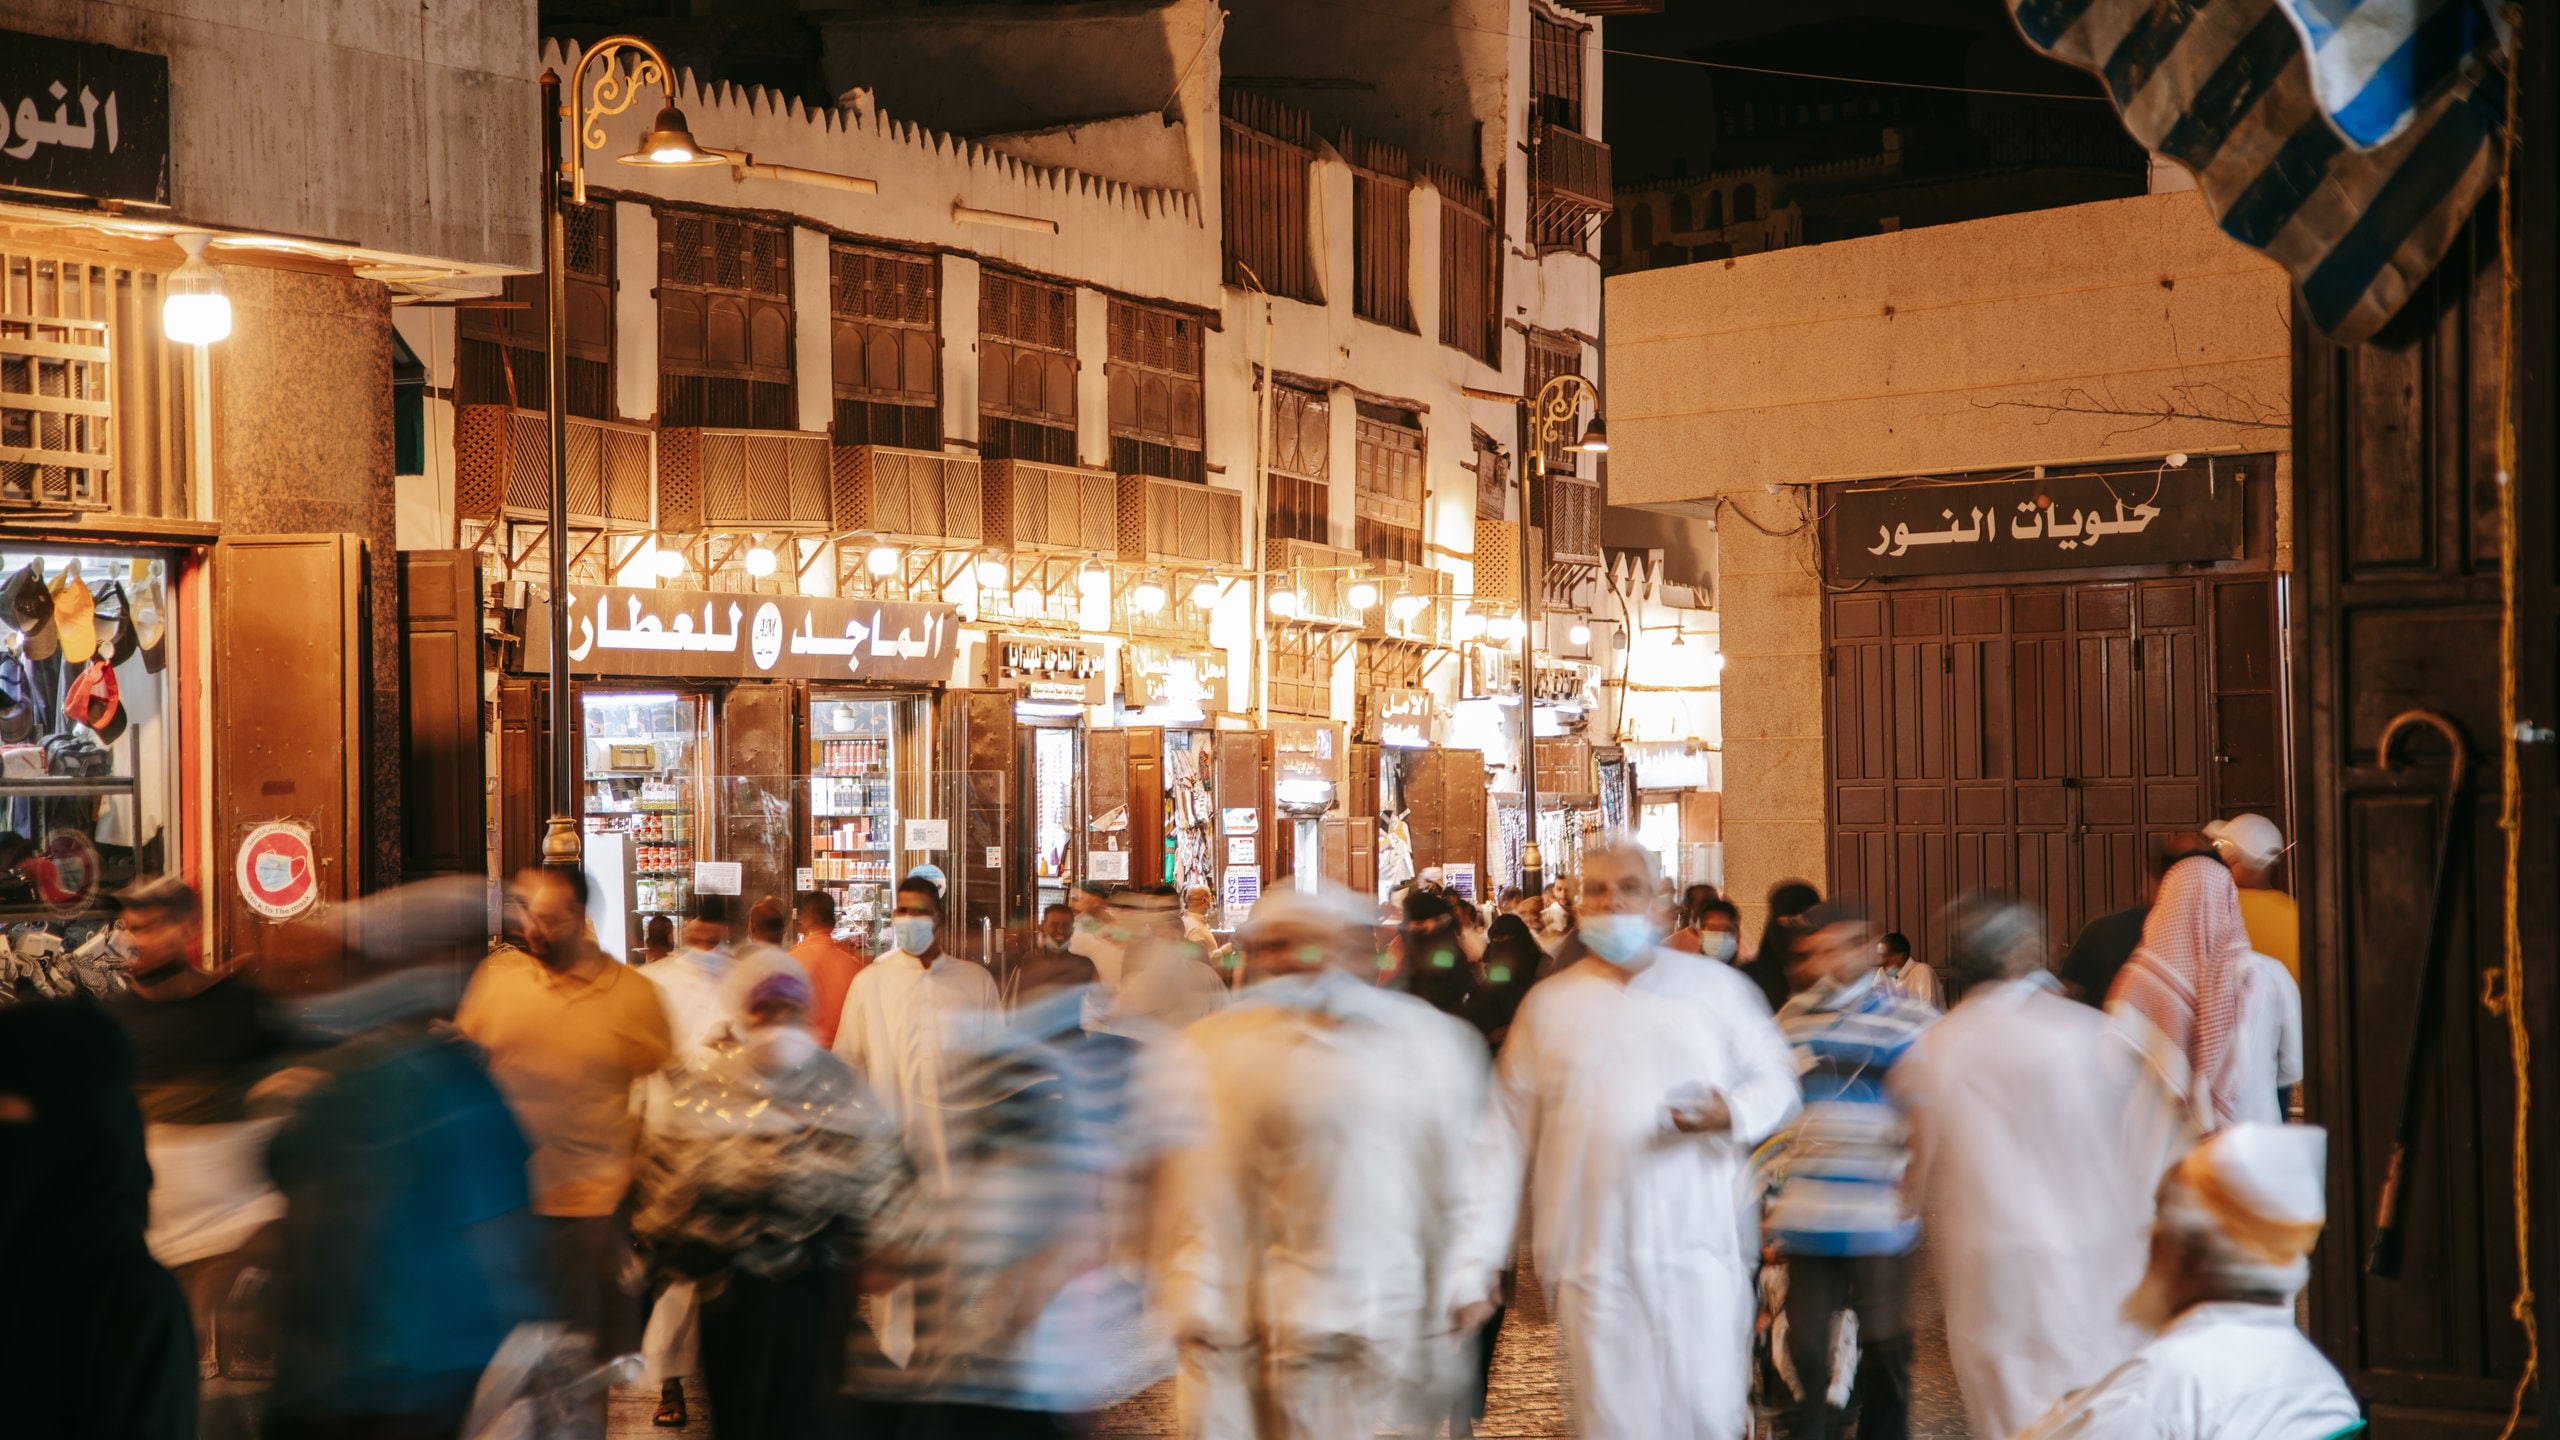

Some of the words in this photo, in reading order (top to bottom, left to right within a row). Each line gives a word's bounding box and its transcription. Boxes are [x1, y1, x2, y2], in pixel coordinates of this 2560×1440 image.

[1867, 505, 1996, 557] النور
[2011, 498, 2161, 550] حلويات
[755, 618, 777, 640] AM
[791, 608, 944, 673] الماجد
[1381, 693, 1430, 719] الامل
